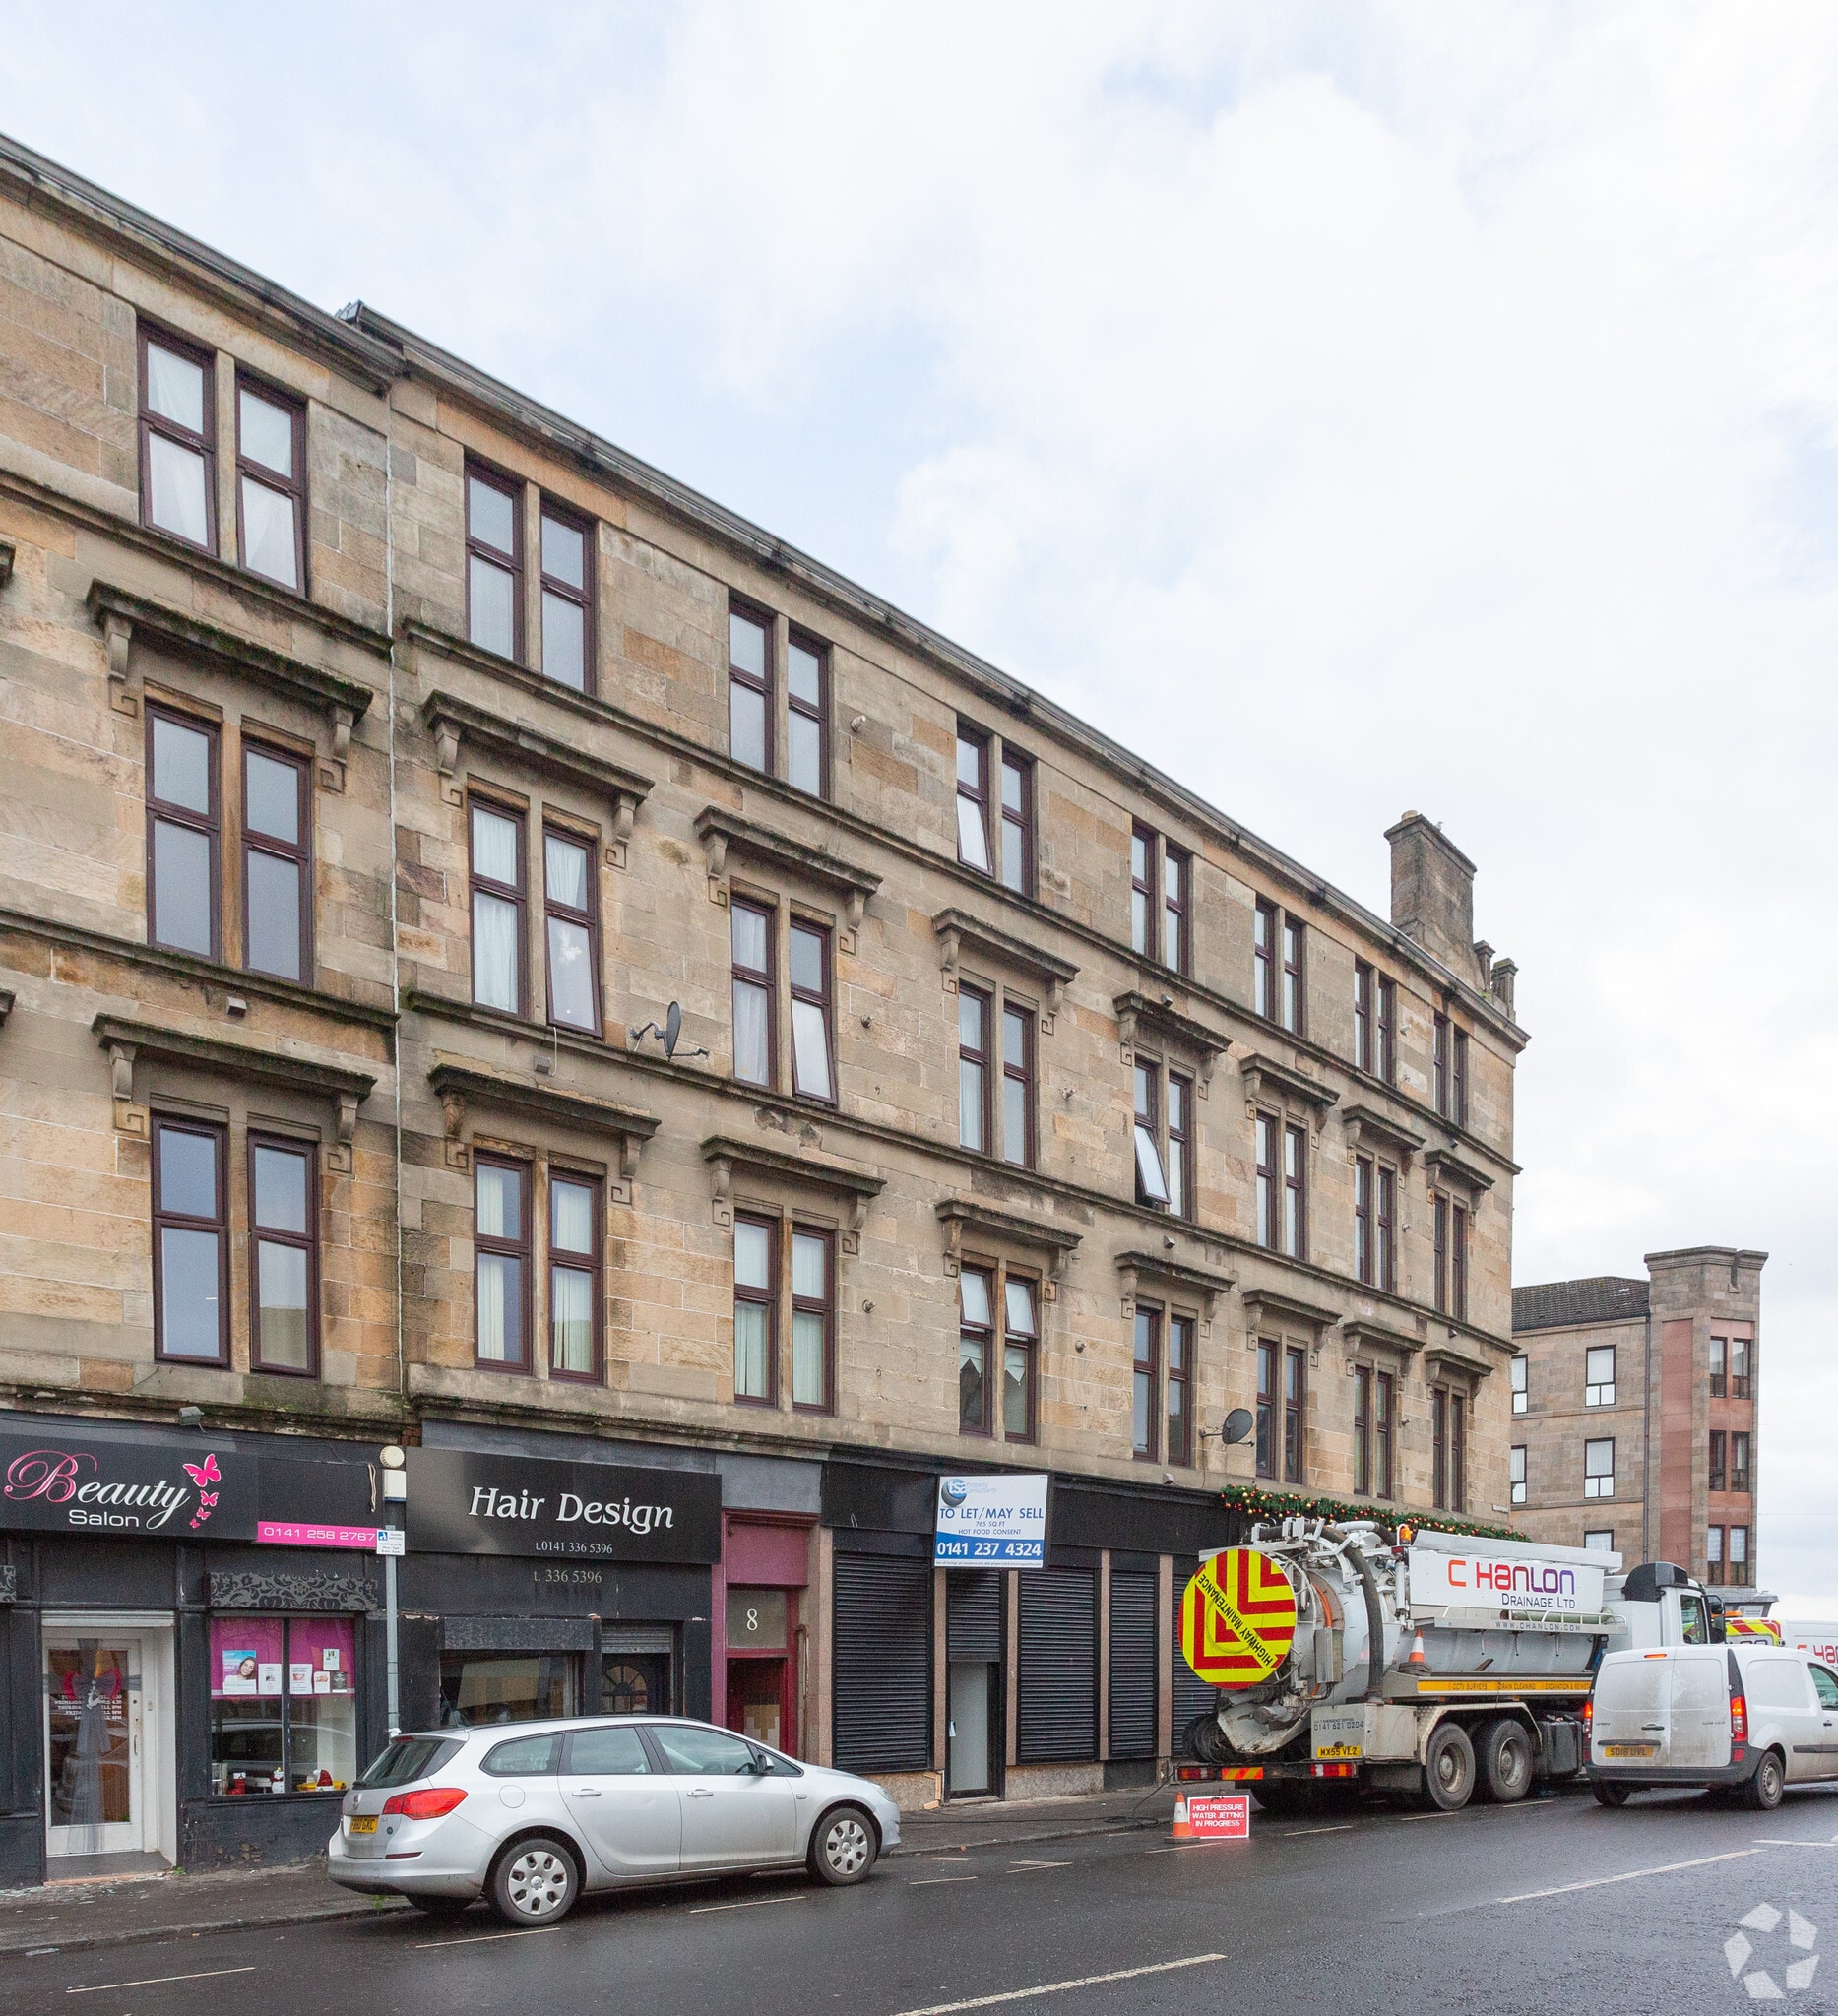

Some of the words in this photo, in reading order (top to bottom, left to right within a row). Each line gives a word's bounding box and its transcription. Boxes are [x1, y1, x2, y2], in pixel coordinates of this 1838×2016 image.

[4, 1450, 190, 1529] Beauty
[69, 1509, 139, 1527] Salon
[468, 1486, 545, 1520] Hair
[555, 1492, 674, 1535] Design
[940, 1507, 956, 1519] TO
[961, 1506, 1014, 1520] LET/MAY
[1019, 1507, 1044, 1519] SELL
[264, 1527, 300, 1538] 0141
[307, 1529, 336, 1540] 258
[339, 1532, 376, 1542] 2767
[535, 1541, 565, 1552] t.0141
[568, 1542, 588, 1553] 336
[589, 1543, 613, 1554] 5396
[936, 1542, 969, 1556] 0141
[974, 1542, 1000, 1556] 237
[1004, 1543, 1042, 1557] 4324
[545, 1569, 569, 1583] 336
[572, 1570, 602, 1584] 5396
[1447, 1559, 1467, 1588] C
[1197, 1574, 1243, 1630] MAINTENANCE
[1501, 1593, 1553, 1608] DRAINAGE
[746, 1608, 758, 1631] 8
[1495, 1621, 1581, 1632] WWW.CHANLON.COM
[1240, 1627, 1273, 1667] HIGHWAY
[1320, 1747, 1341, 1757] MX55
